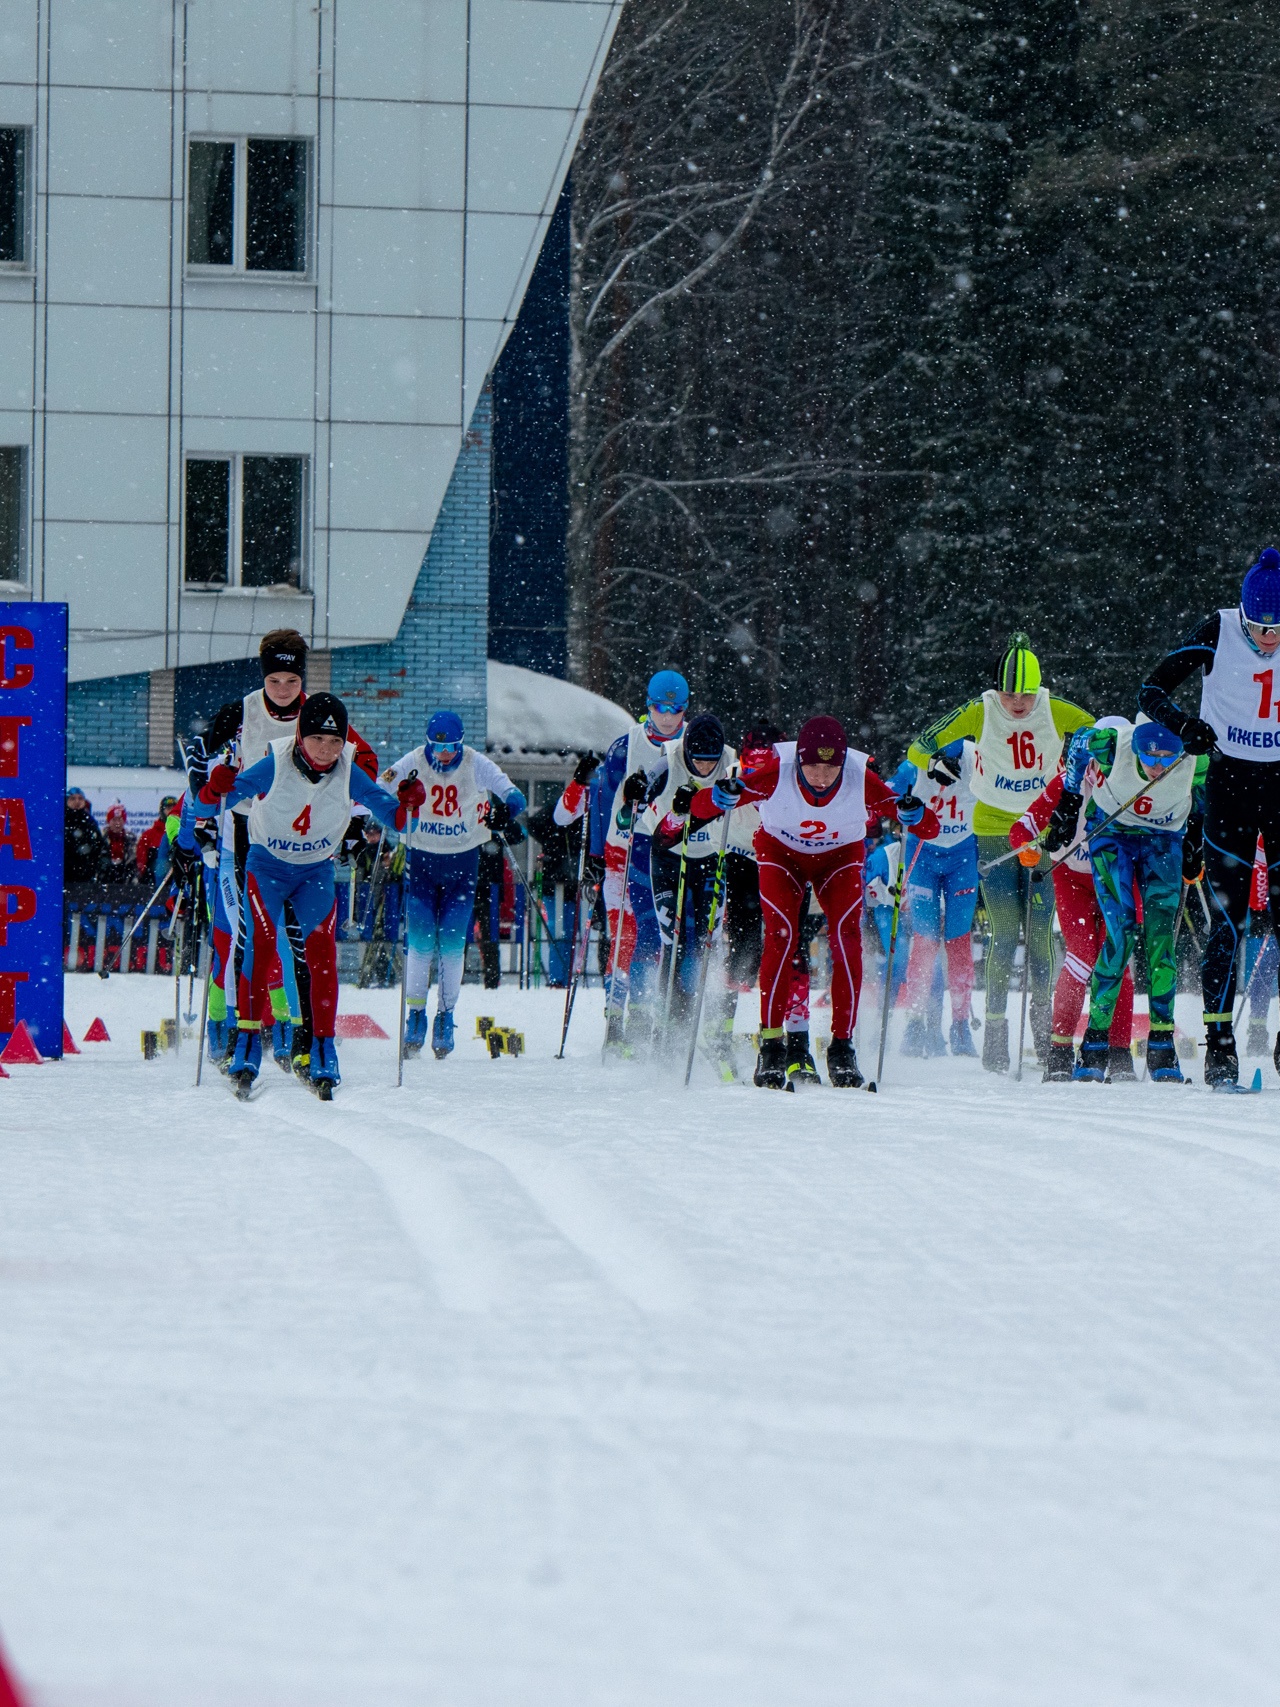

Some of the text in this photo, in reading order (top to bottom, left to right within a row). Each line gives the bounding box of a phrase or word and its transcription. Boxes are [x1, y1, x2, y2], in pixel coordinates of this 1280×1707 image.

[1253, 669, 1273, 718] 1
[1007, 731, 1035, 769] 16
[995, 774, 1047, 792] ИЖЕВСК
[431, 785, 458, 817] 28
[930, 795, 957, 819] 21
[1134, 796, 1153, 815] 6
[293, 804, 311, 836] 4
[420, 821, 467, 836] ИЖЕВСК
[799, 820, 827, 839] 2
